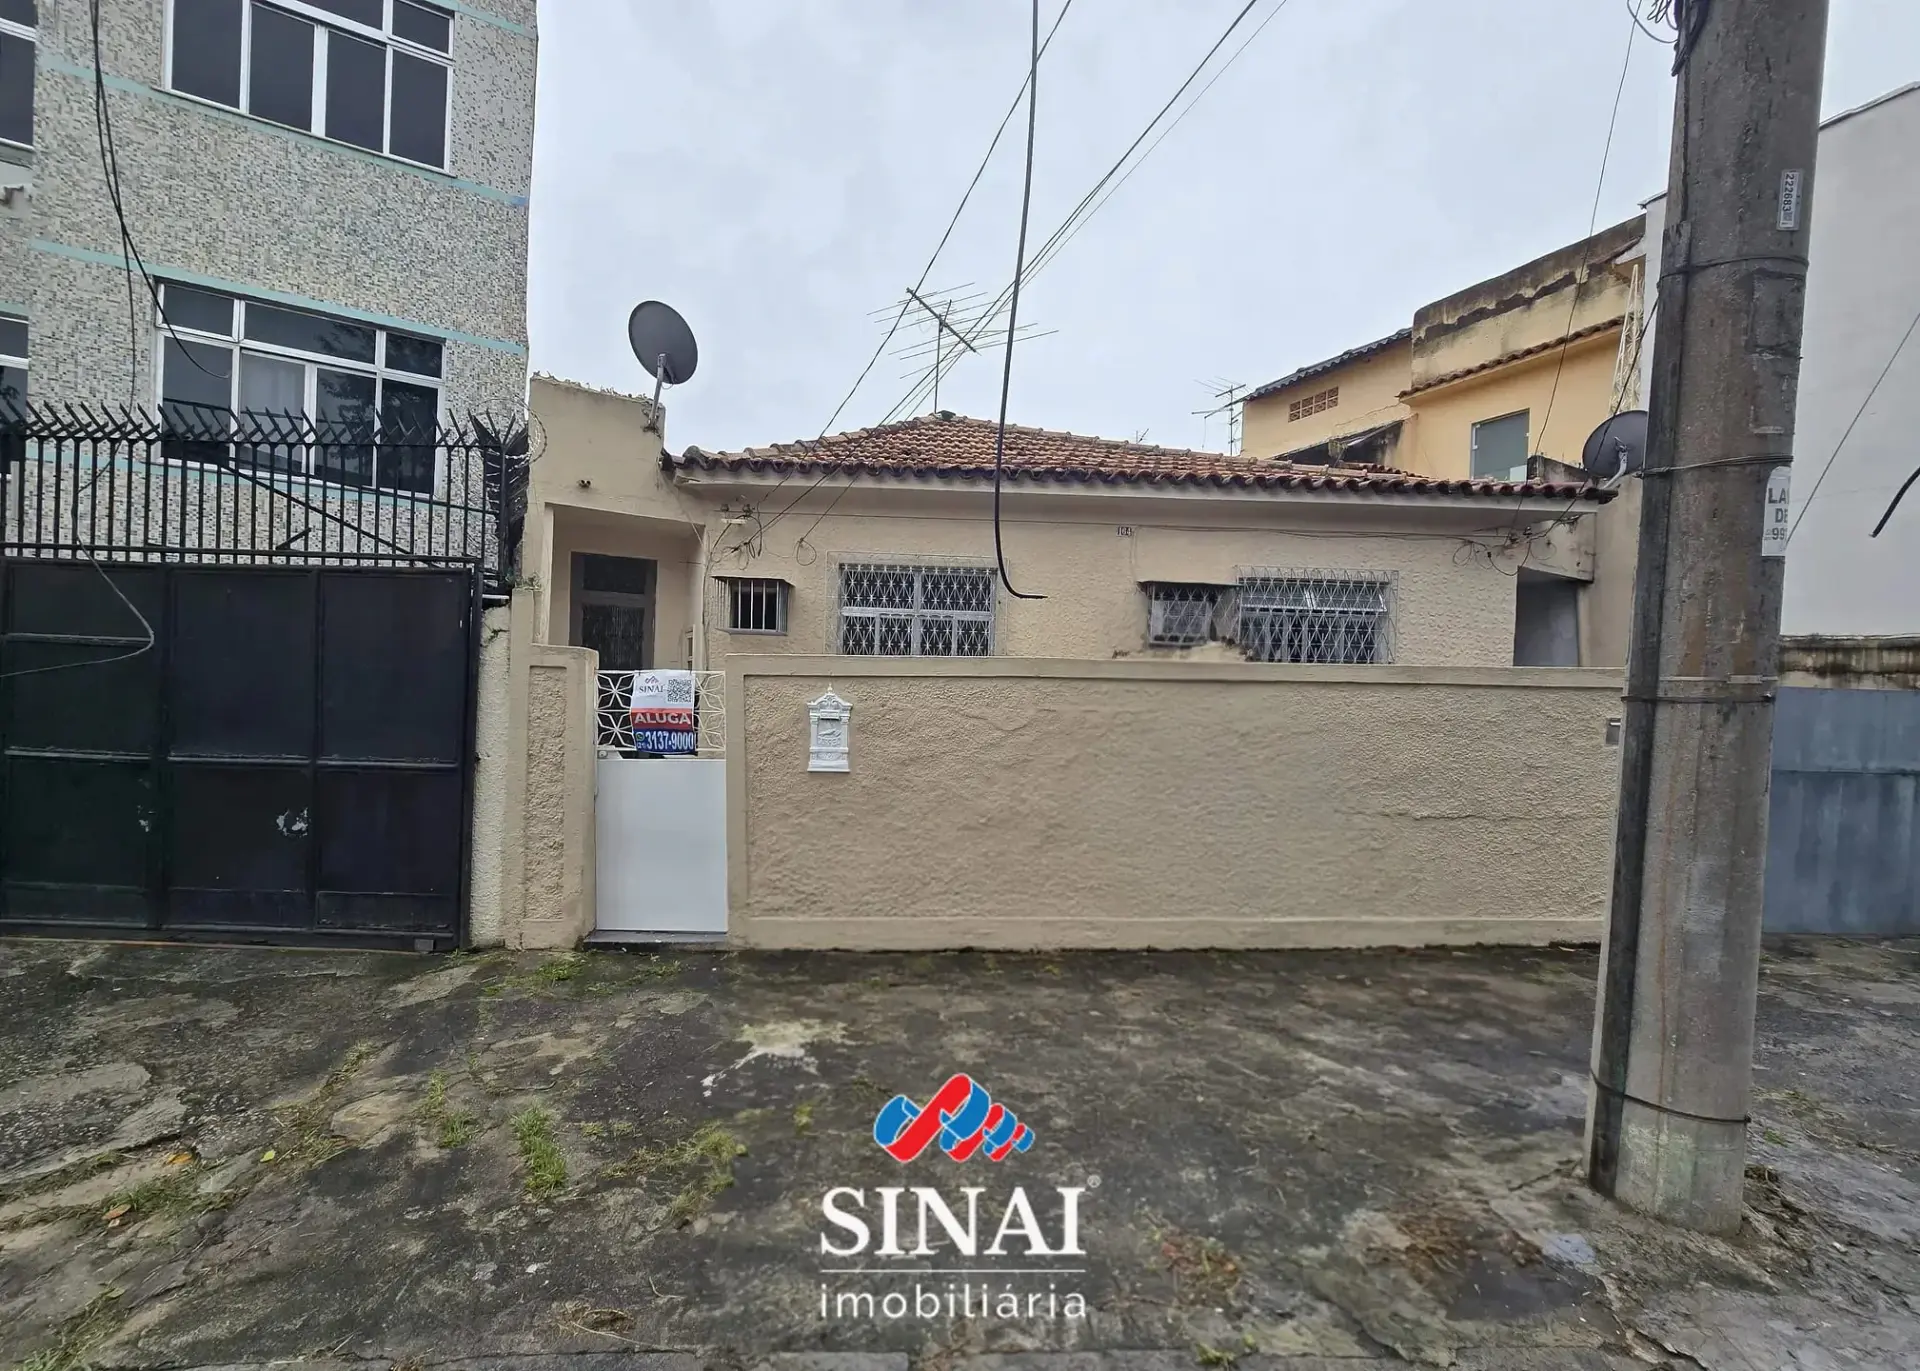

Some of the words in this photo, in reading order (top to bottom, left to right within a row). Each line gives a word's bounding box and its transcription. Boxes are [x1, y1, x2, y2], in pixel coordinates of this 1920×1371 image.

[1782, 173, 1795, 212] 222683
[639, 685, 664, 693] SINAI
[634, 712, 691, 724] ALUGA
